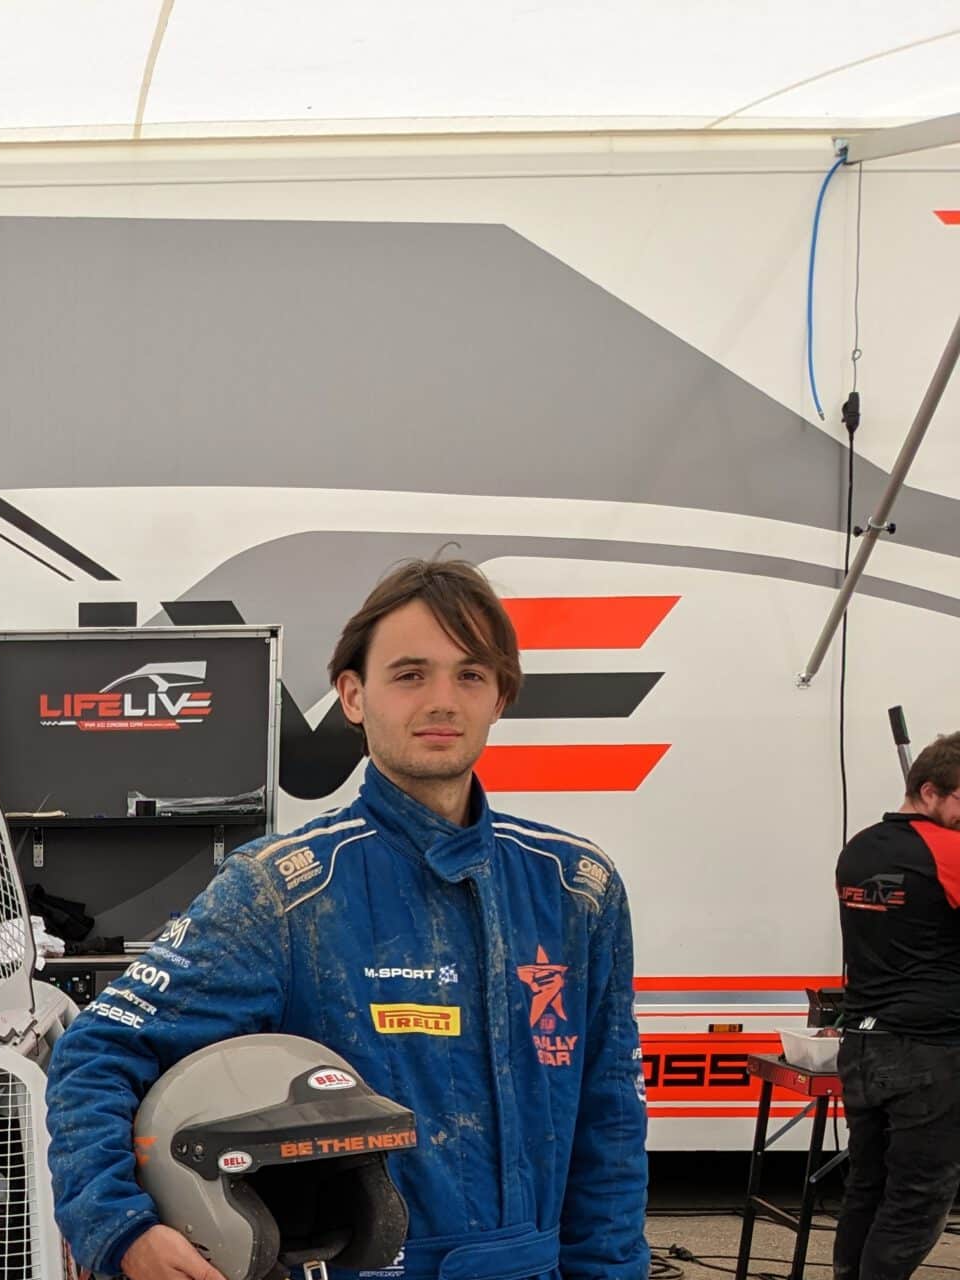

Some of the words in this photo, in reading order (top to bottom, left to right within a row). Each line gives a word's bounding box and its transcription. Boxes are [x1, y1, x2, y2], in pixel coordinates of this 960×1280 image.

[40, 692, 213, 717] LIFELIVE
[279, 849, 315, 876] OMP
[84, 1000, 144, 1029] yseat
[378, 1010, 451, 1031] PIRELLI
[315, 1074, 352, 1085] BELL
[280, 1140, 313, 1158] BE
[316, 1136, 365, 1153] THE
[224, 1157, 246, 1166] BELL
